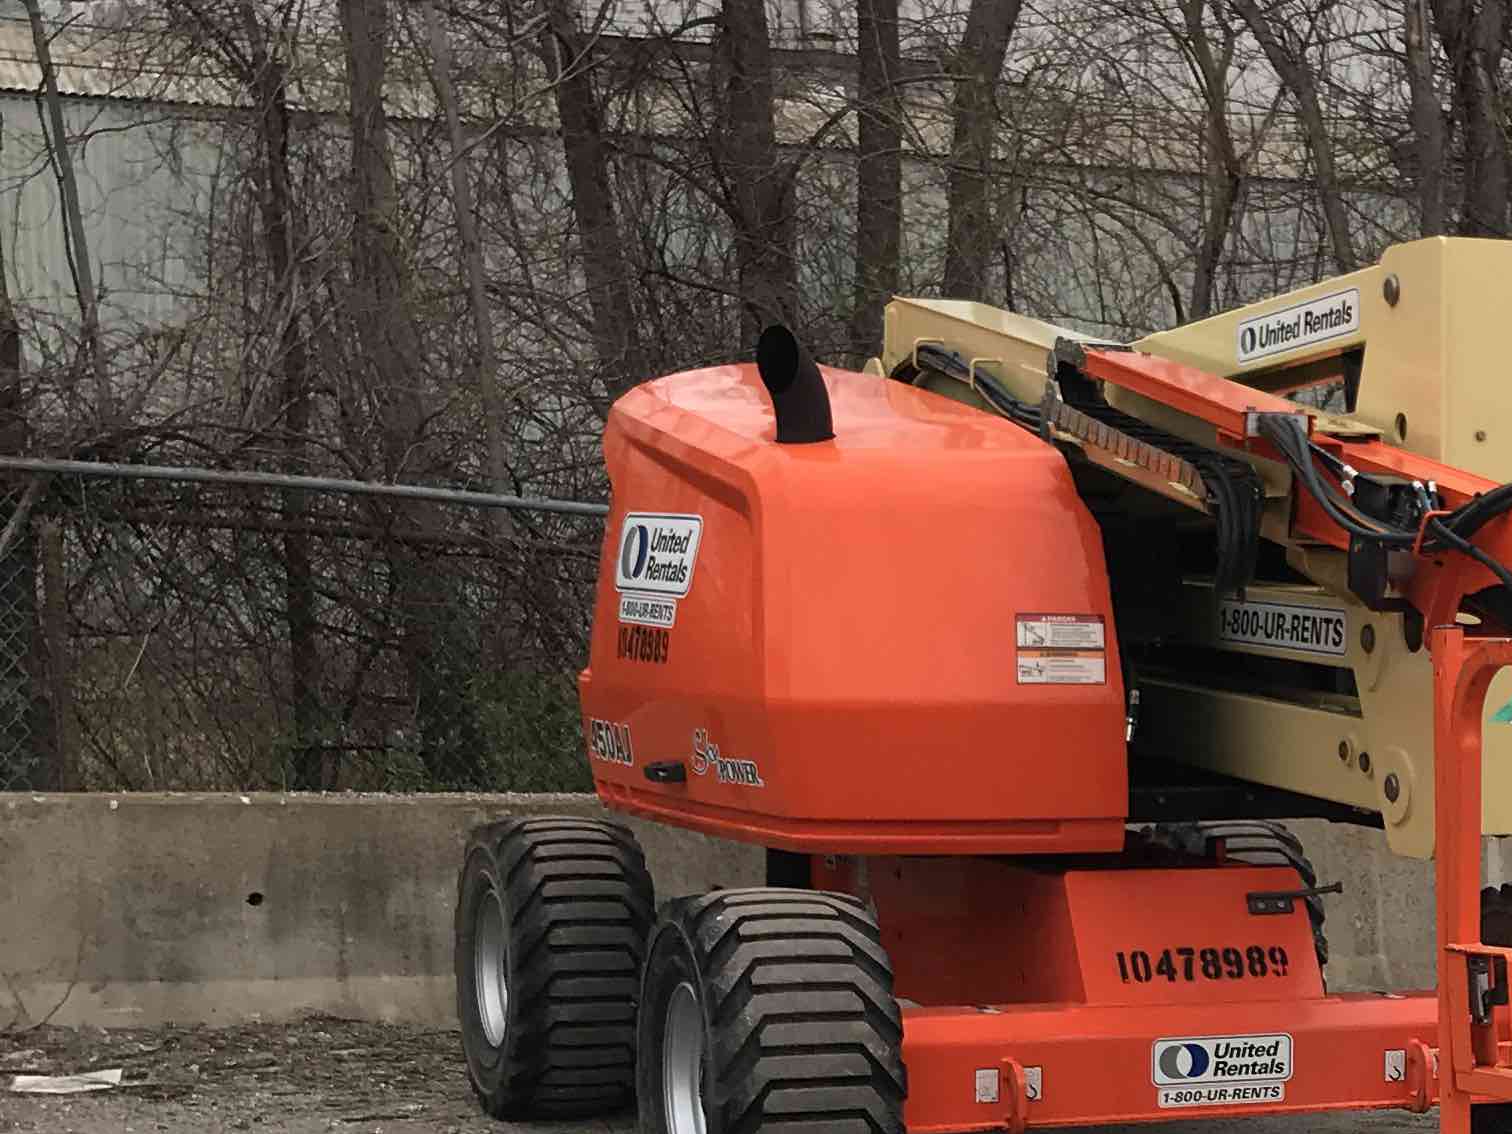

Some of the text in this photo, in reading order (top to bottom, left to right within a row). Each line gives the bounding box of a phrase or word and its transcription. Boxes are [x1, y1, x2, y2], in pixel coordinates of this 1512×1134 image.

[1259, 299, 1353, 349] United Rentals
[650, 527, 693, 554] United
[644, 555, 688, 584] Rentals
[1221, 607, 1344, 648] 1-800-UR-RENTS
[1116, 945, 1288, 984] 10478989
[1214, 1041, 1280, 1059] United
[1213, 1058, 1285, 1077] Rentals
[1163, 1086, 1280, 1103] 1-800-UR-RENTS
